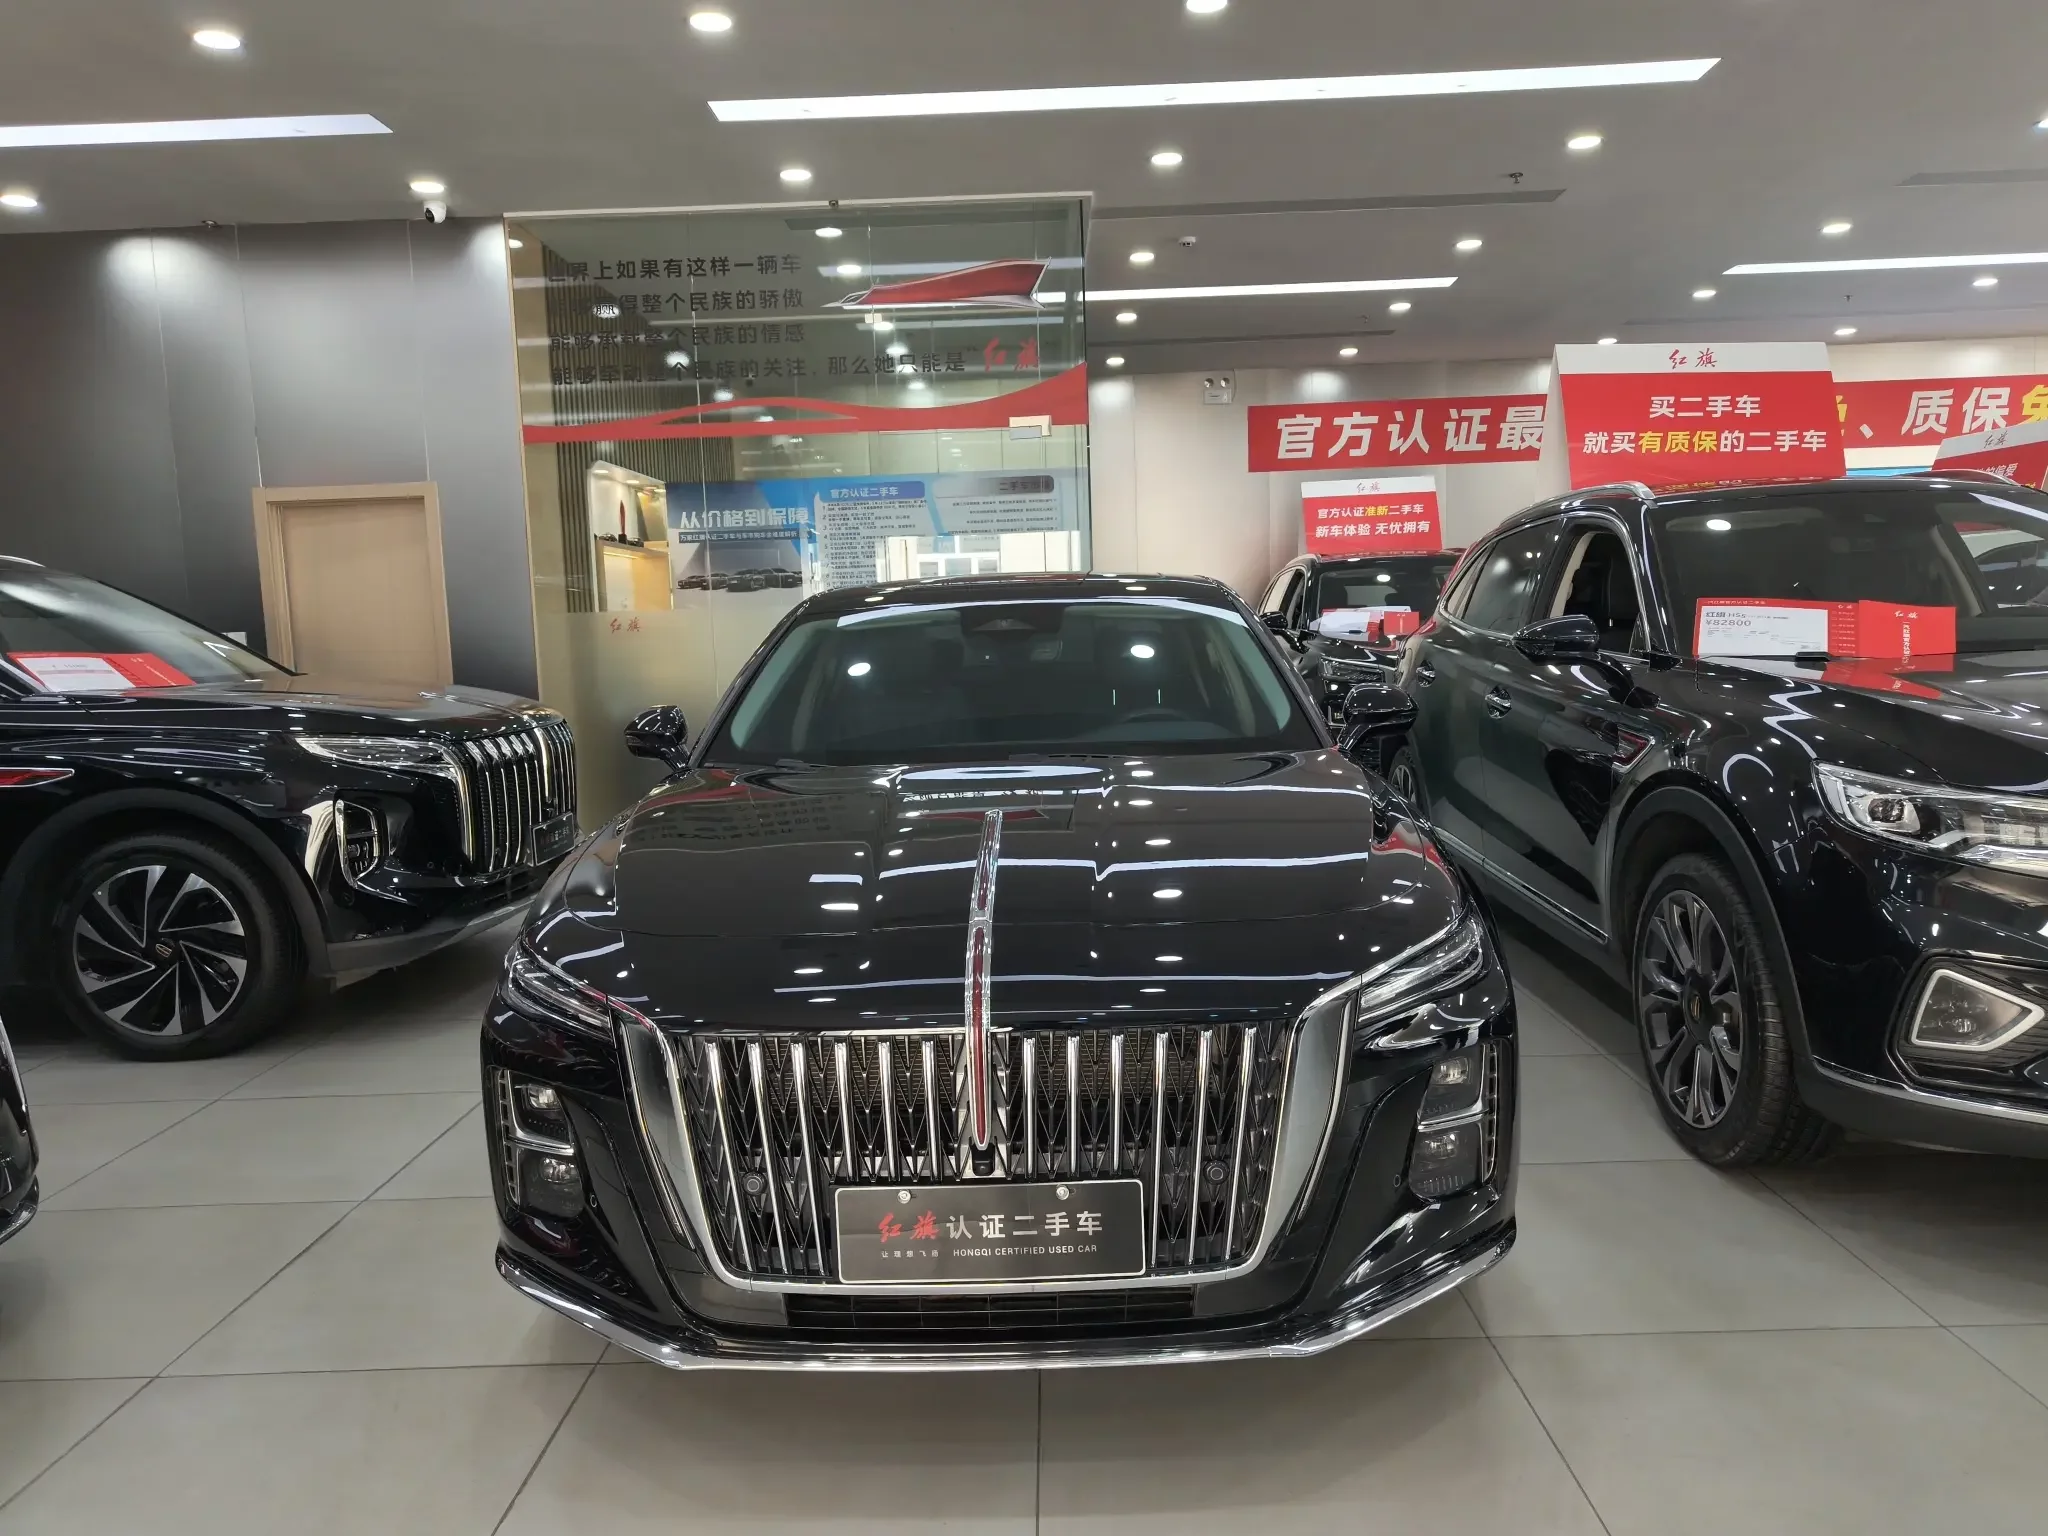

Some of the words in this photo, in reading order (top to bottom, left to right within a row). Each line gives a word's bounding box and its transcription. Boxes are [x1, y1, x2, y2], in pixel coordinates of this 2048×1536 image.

[553, 289, 804, 320] 赢得整个民族的骄傲
[1668, 348, 1718, 369] 红旗
[1649, 395, 1761, 418] 买二手车
[1277, 405, 1544, 459] 官方认证最
[1836, 384, 2048, 436] 、质保
[1583, 430, 1827, 454] 就买有质保的二手车
[830, 486, 899, 499] 官方认证二手车
[680, 507, 808, 529] 从价格到保障
[1317, 503, 1424, 519] 官方认证准新二手车
[1315, 524, 1371, 538] 新车体验
[1375, 520, 1431, 535] 无忧拥有
[1705, 619, 1752, 627] ¥82800
[953, 1248, 992, 1257] HONGQI
[994, 1246, 1045, 1256] CERTIFIED
[1048, 1245, 1074, 1254] USED
[1077, 1244, 1098, 1253] CAR
